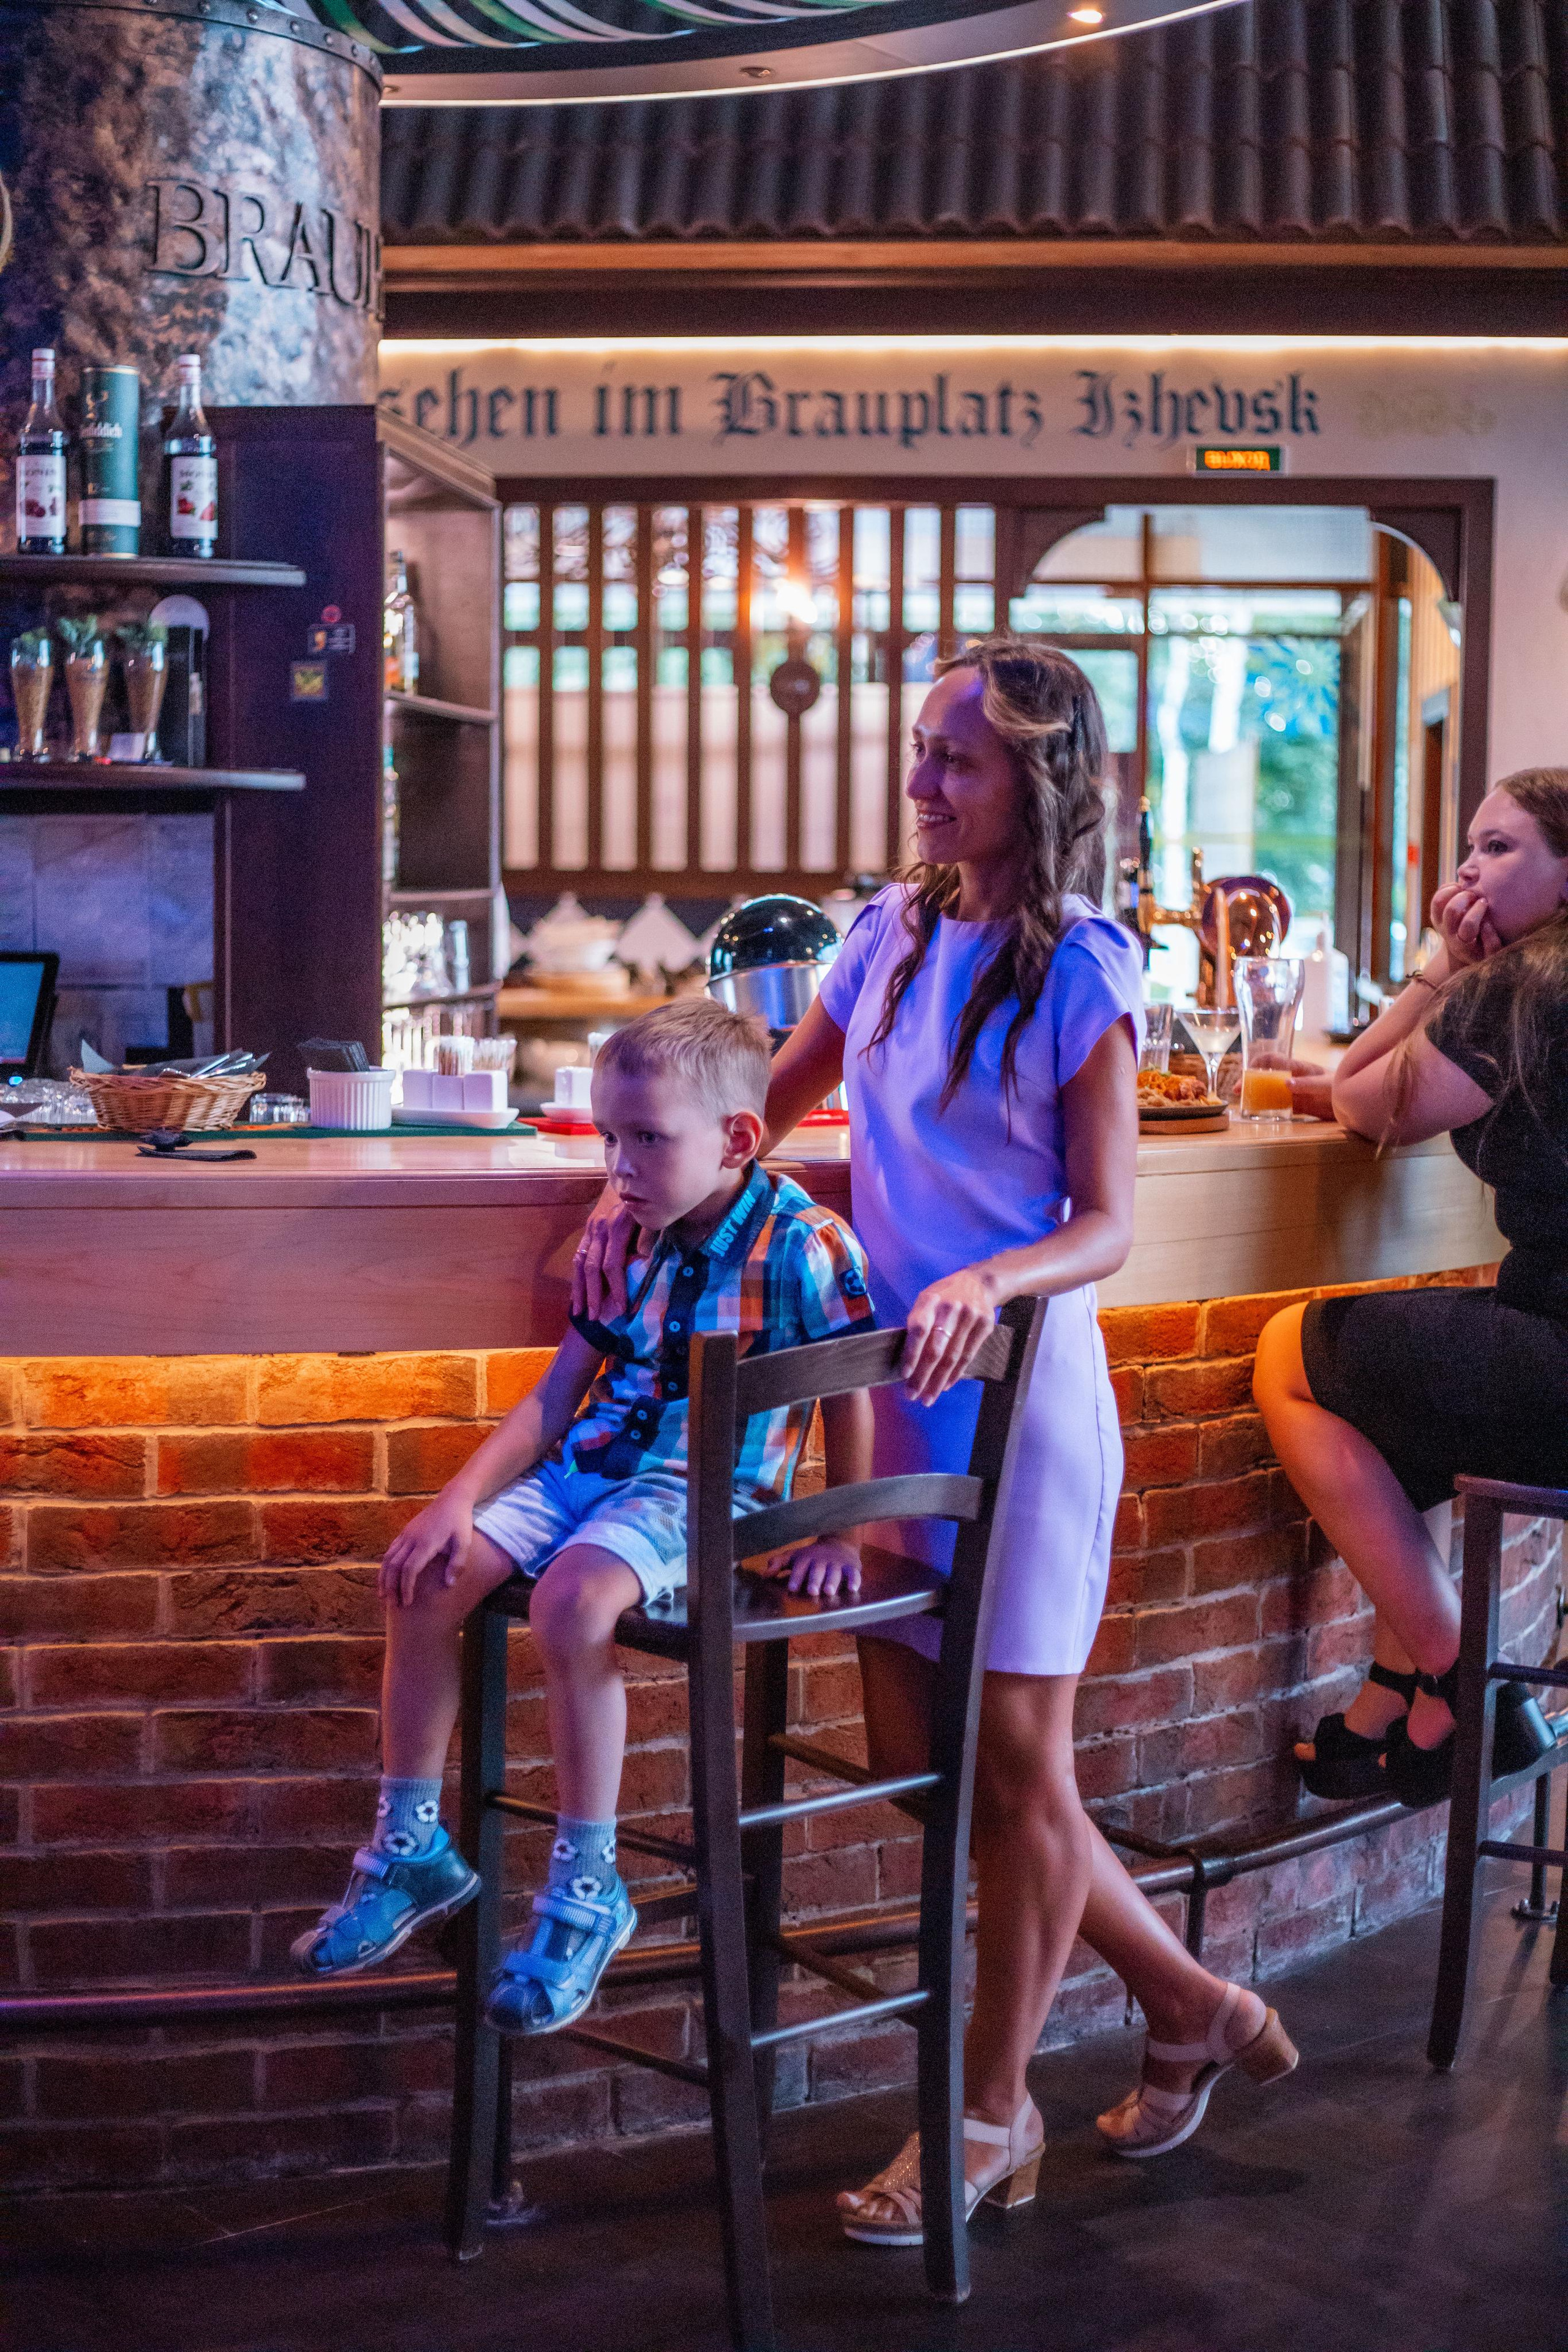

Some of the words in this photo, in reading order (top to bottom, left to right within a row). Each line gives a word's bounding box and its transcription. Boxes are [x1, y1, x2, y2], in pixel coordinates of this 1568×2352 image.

[593, 359, 684, 437] im
[710, 371, 1042, 449] Brauplatz
[1073, 369, 1321, 449] Izhevsk
[710, 1219, 738, 1257] JUST
[731, 1189, 756, 1225] WIN
